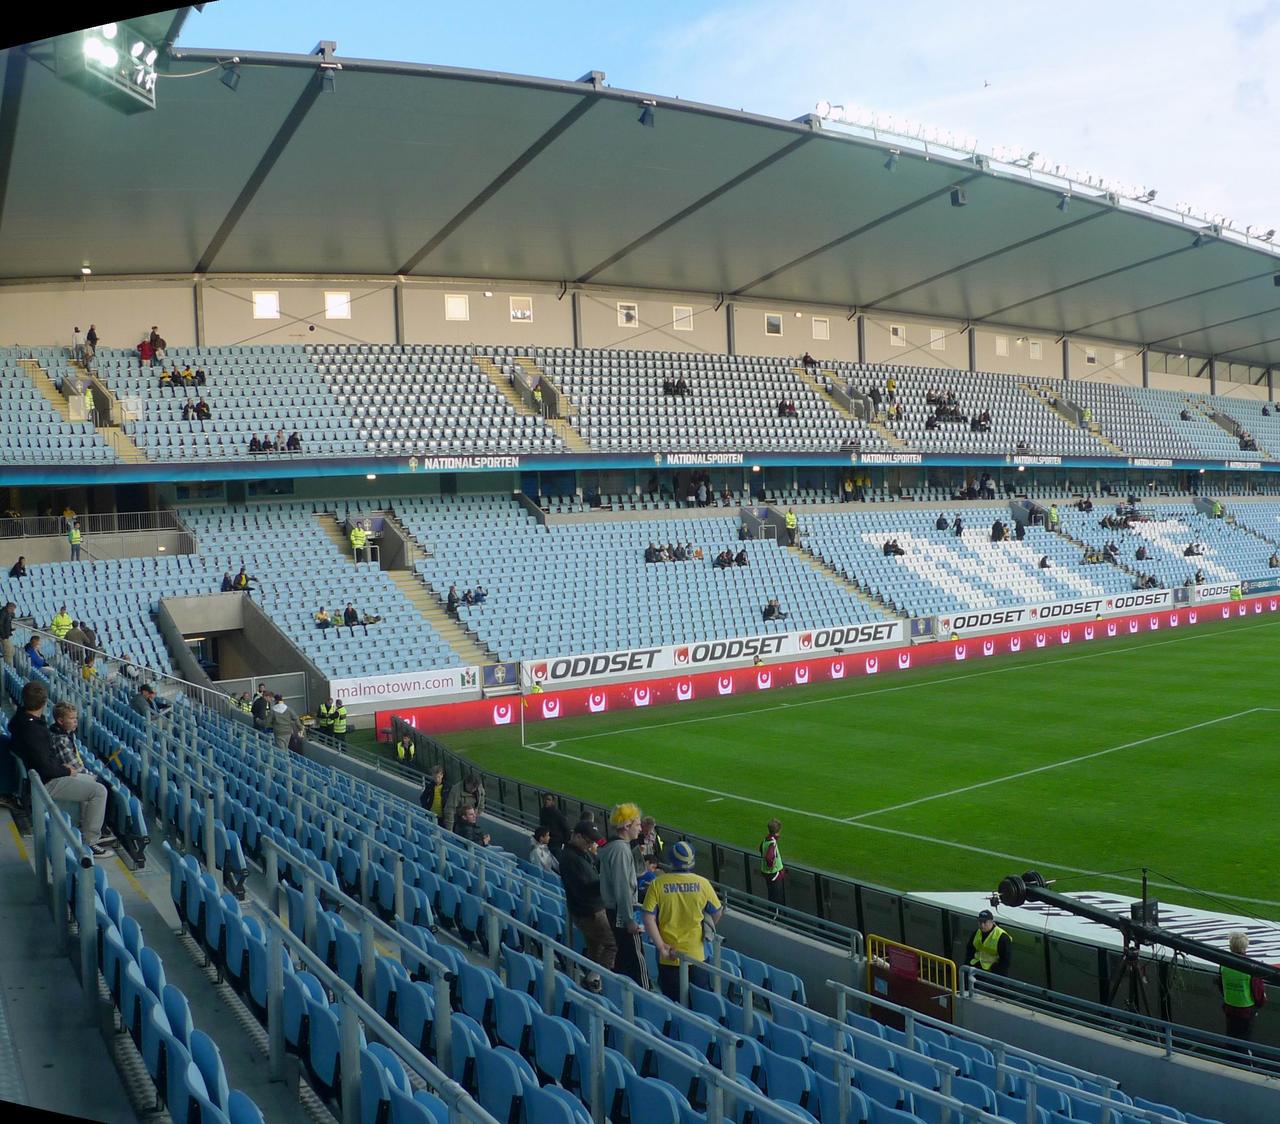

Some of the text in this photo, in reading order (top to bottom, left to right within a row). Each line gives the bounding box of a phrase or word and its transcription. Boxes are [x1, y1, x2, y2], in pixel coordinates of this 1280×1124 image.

[425, 456, 519, 470] NATIONALSPORTEN
[667, 453, 743, 465] NATIONALSPORTEN
[861, 453, 922, 464] NATIONALSPORTEN
[1013, 455, 1061, 465] NATIONALSPORTEN
[953, 592, 1169, 630] ODDSET ODDSET ODDSET
[551, 623, 898, 679] ODDSET ODDSET ODDSET
[337, 676, 454, 698] malmotown.com
[664, 883, 699, 893] SWEDEN
